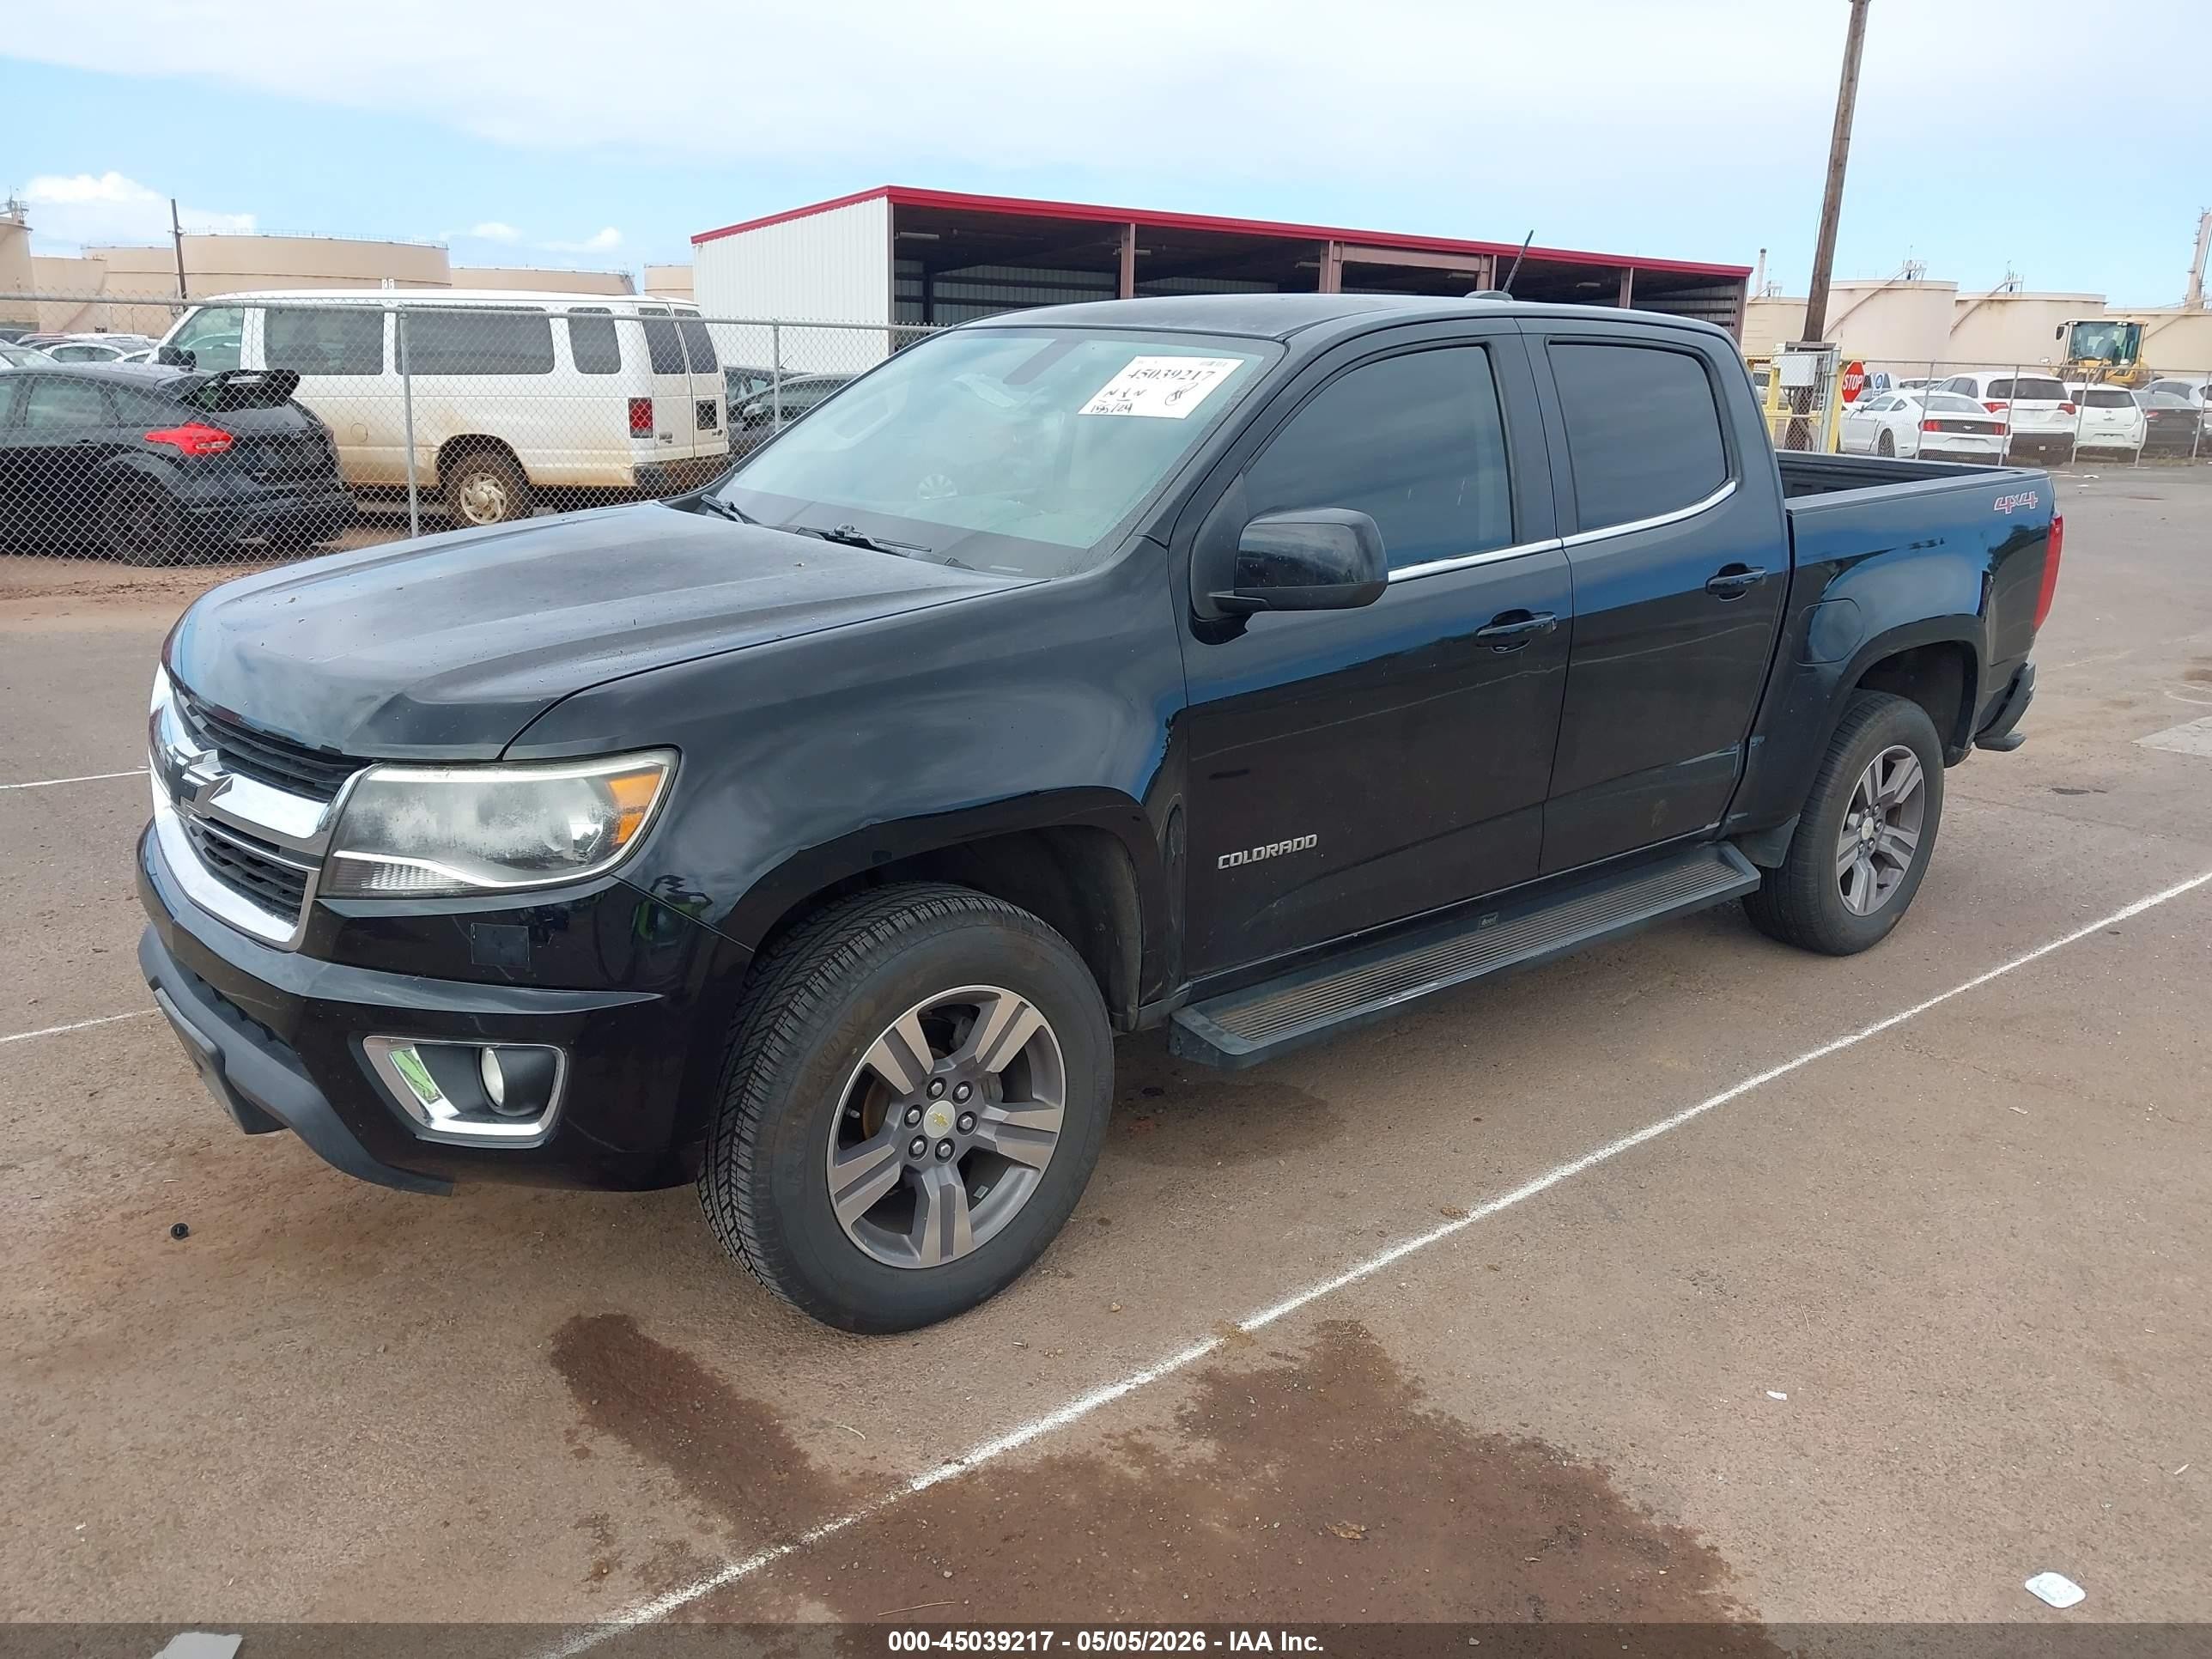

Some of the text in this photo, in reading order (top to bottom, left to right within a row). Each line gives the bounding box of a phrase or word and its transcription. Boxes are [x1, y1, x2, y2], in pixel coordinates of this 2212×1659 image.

[1127, 368, 1217, 380] 45039217
[1843, 374, 1863, 391] STOP
[1218, 834, 1317, 869] COLORADO
